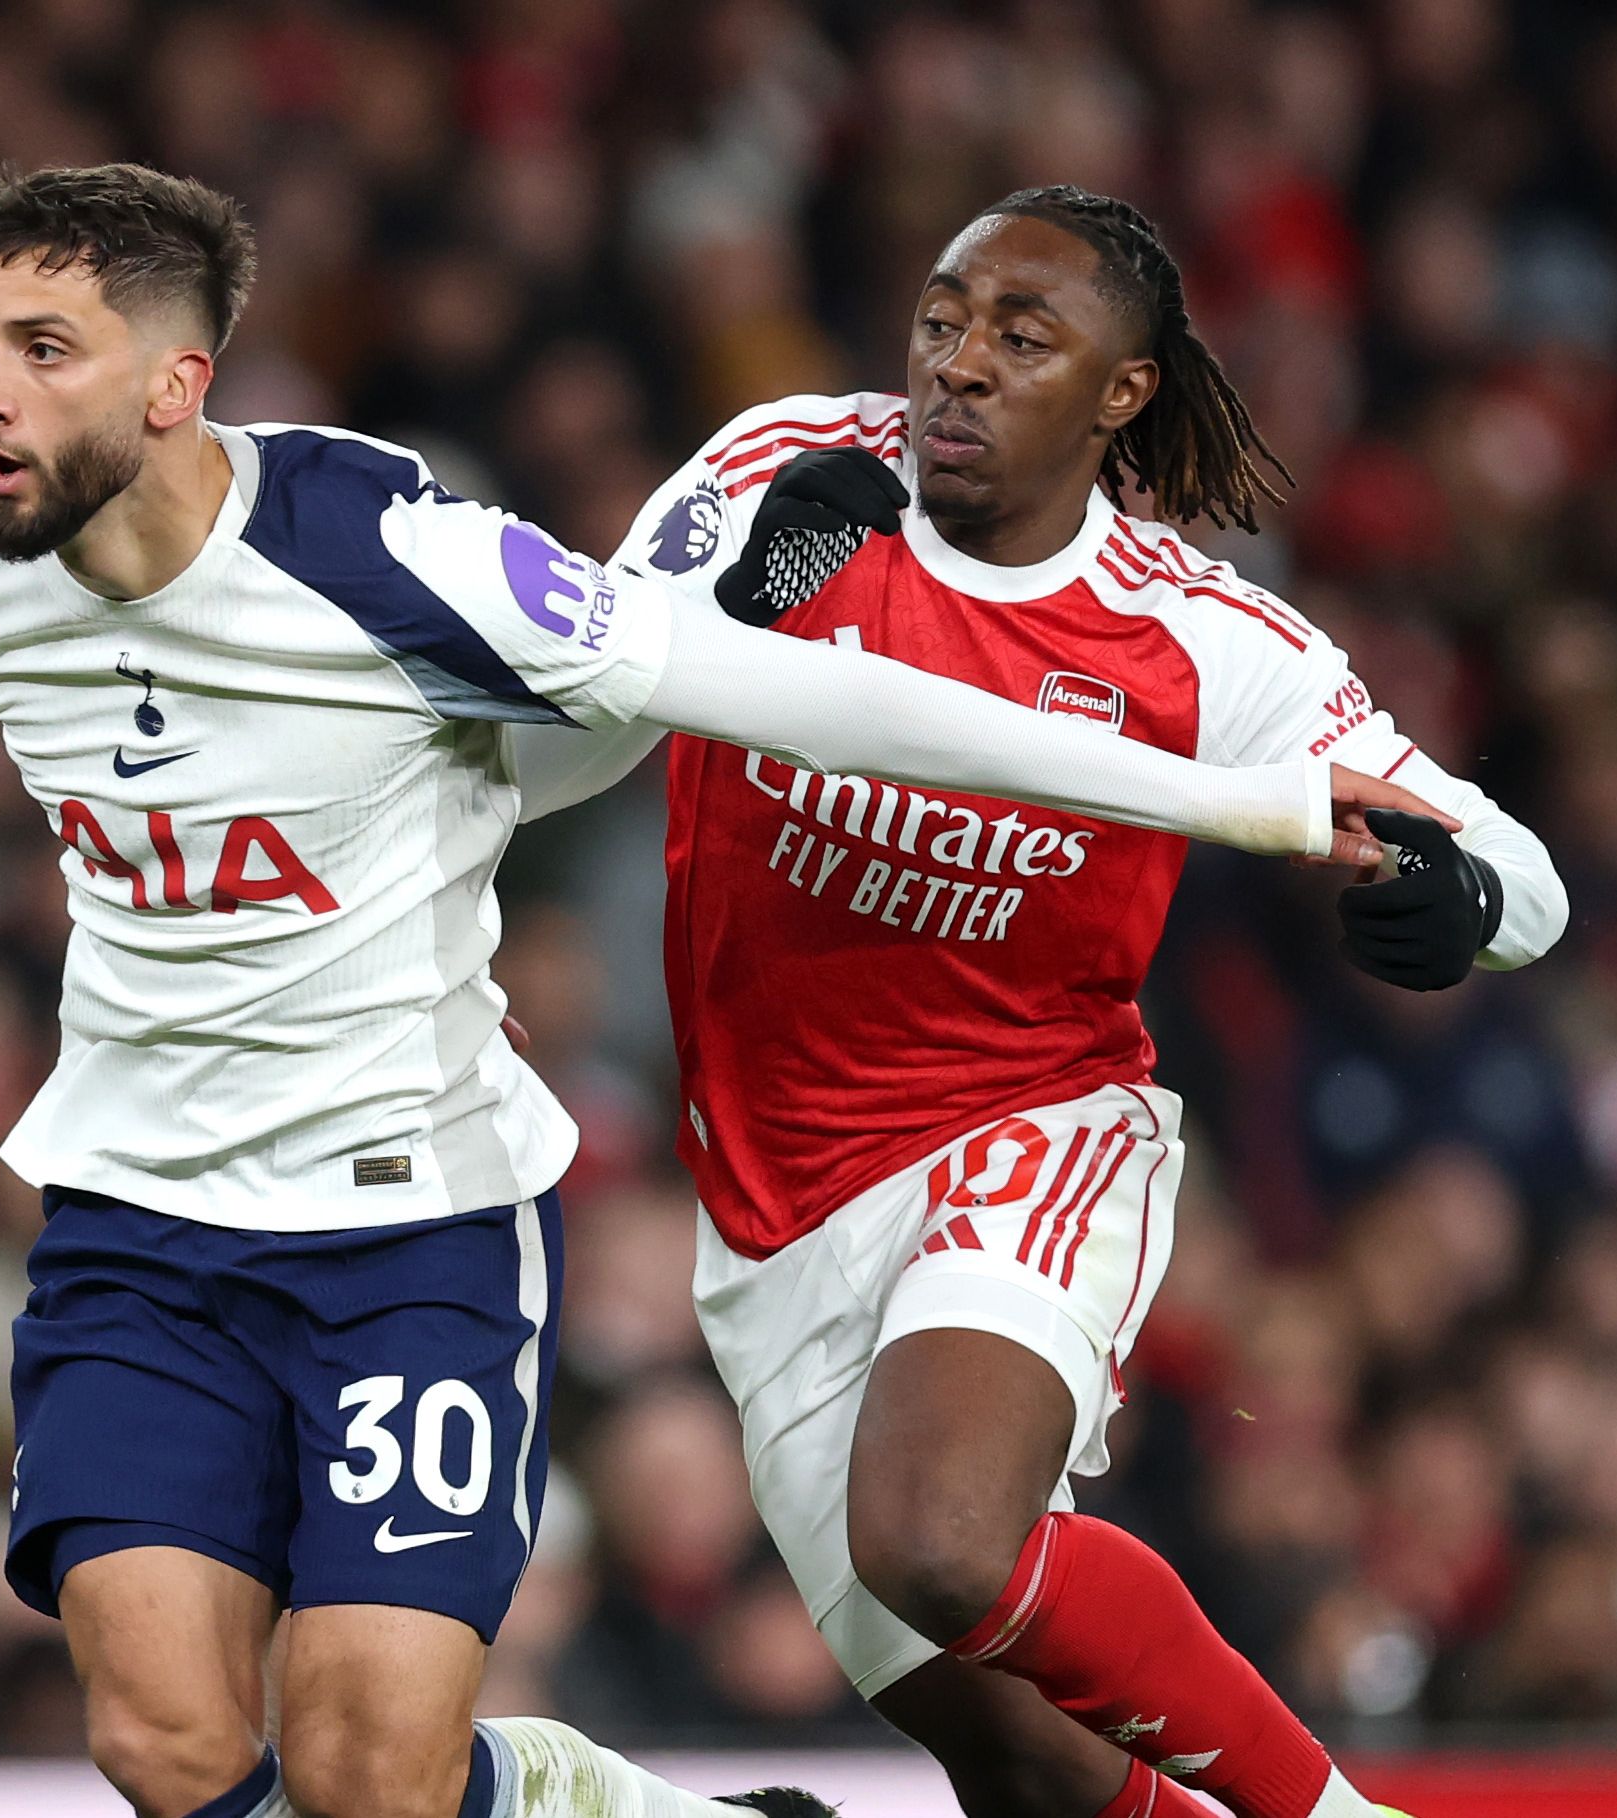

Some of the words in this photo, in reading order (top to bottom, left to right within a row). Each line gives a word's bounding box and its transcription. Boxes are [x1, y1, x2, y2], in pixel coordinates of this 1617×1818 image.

[1050, 685, 1113, 713] Arsenal
[59, 798, 341, 915] AIA
[768, 820, 849, 898] FLY
[848, 858, 1024, 942] BETTER
[917, 1116, 1052, 1224] 10
[328, 1374, 493, 1517] 30
